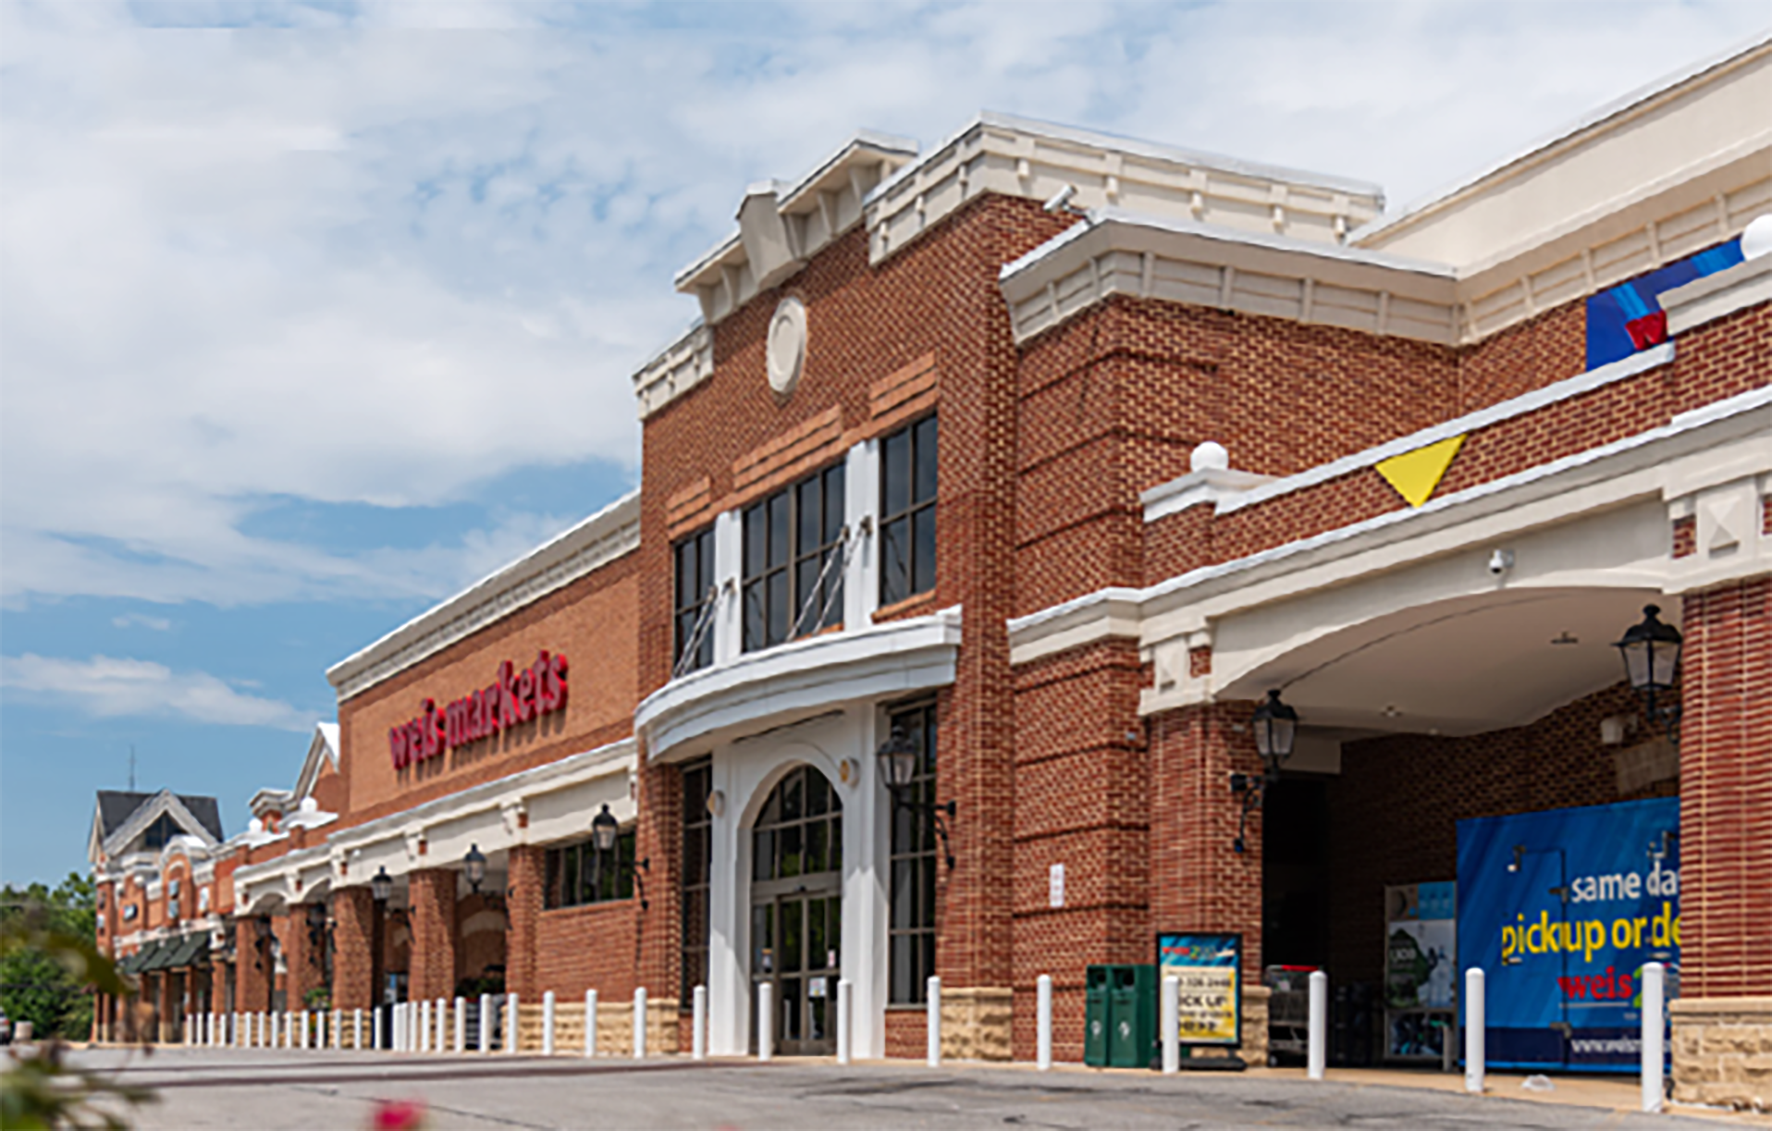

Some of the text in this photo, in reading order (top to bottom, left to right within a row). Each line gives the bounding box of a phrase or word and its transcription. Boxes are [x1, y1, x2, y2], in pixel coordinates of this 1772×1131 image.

[388, 650, 569, 770] weis markets
[1571, 860, 1680, 903] same da
[1502, 909, 1606, 966] pickup
[1611, 916, 1647, 948] or
[1557, 965, 1633, 999] weis
